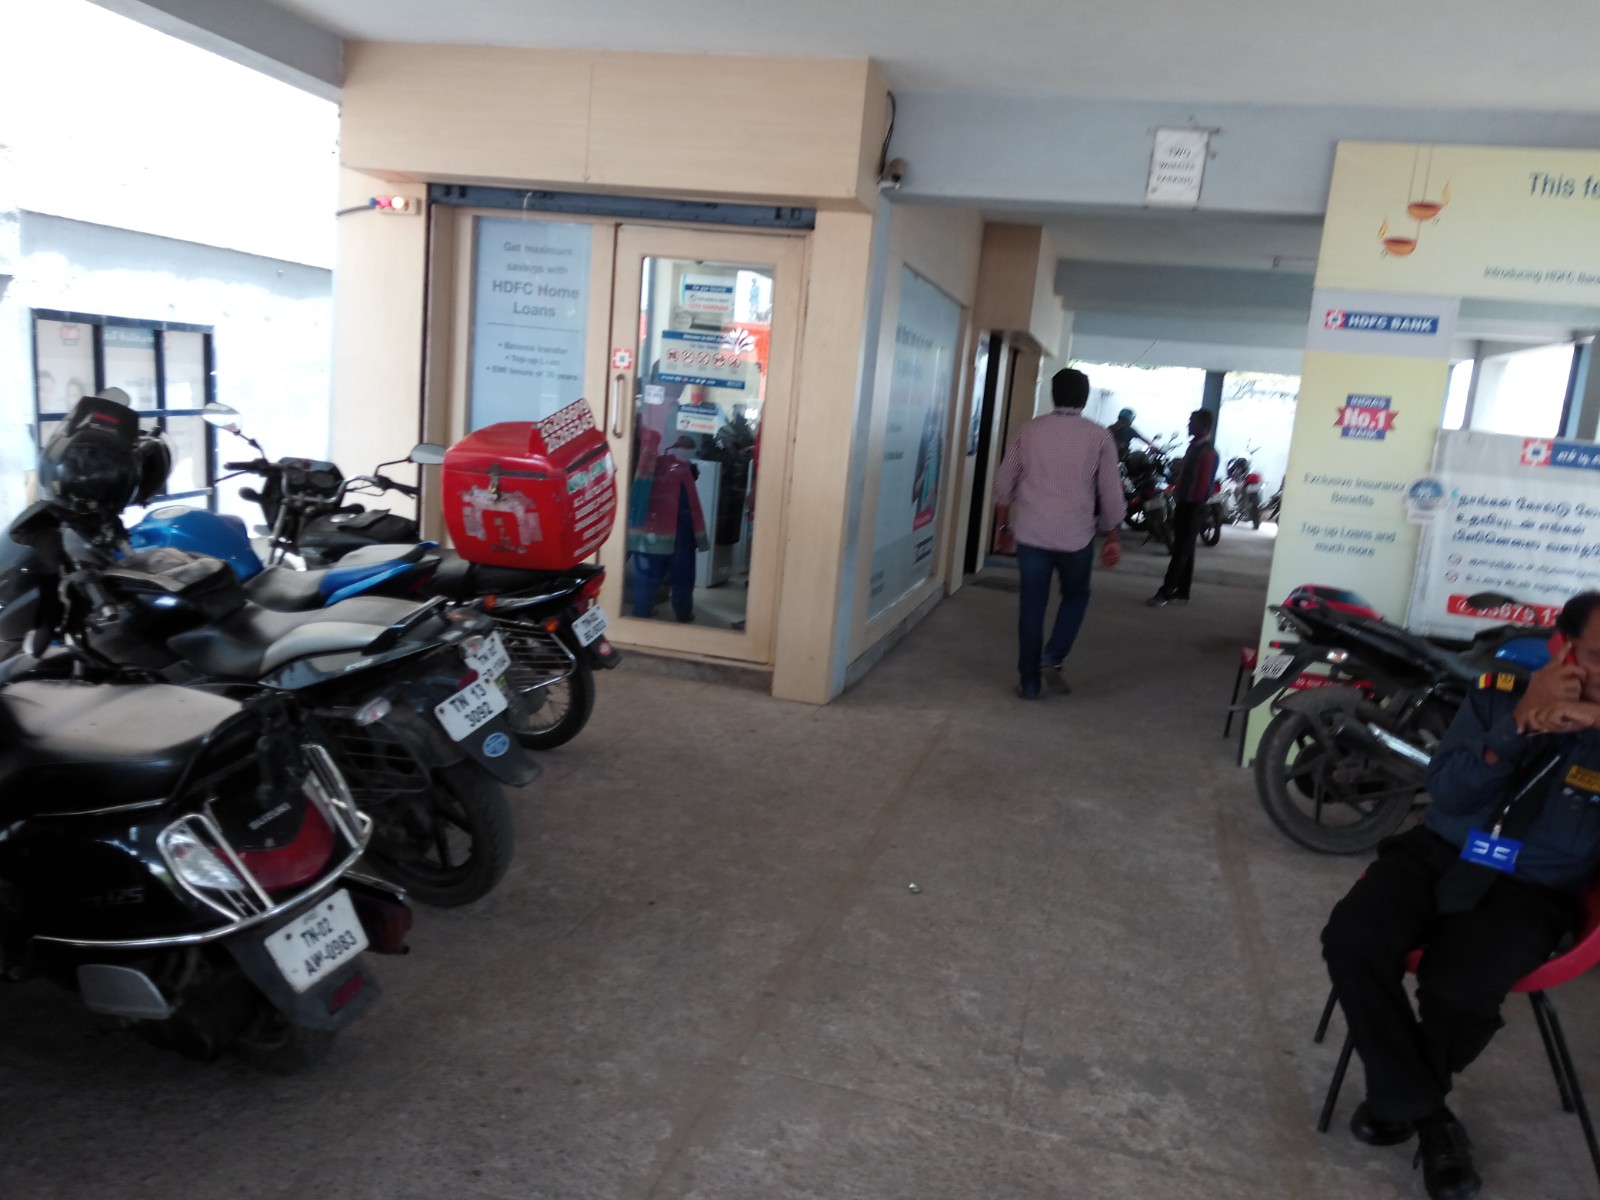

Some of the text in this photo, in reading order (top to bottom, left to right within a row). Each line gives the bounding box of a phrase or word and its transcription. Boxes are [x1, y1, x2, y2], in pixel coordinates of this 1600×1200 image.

[1529, 172, 1575, 198] This
[503, 241, 573, 256] Get maximum
[505, 262, 568, 275] savings with
[492, 280, 580, 300] HDFC Home
[512, 301, 557, 318] Loans
[1347, 314, 1433, 333] HDFC BANK
[1343, 407, 1387, 430] No.1
[1330, 491, 1375, 508] Benefits
[449, 683, 488, 713] TN 13
[464, 701, 495, 728] 3092
[301, 917, 334, 949] TN-02
